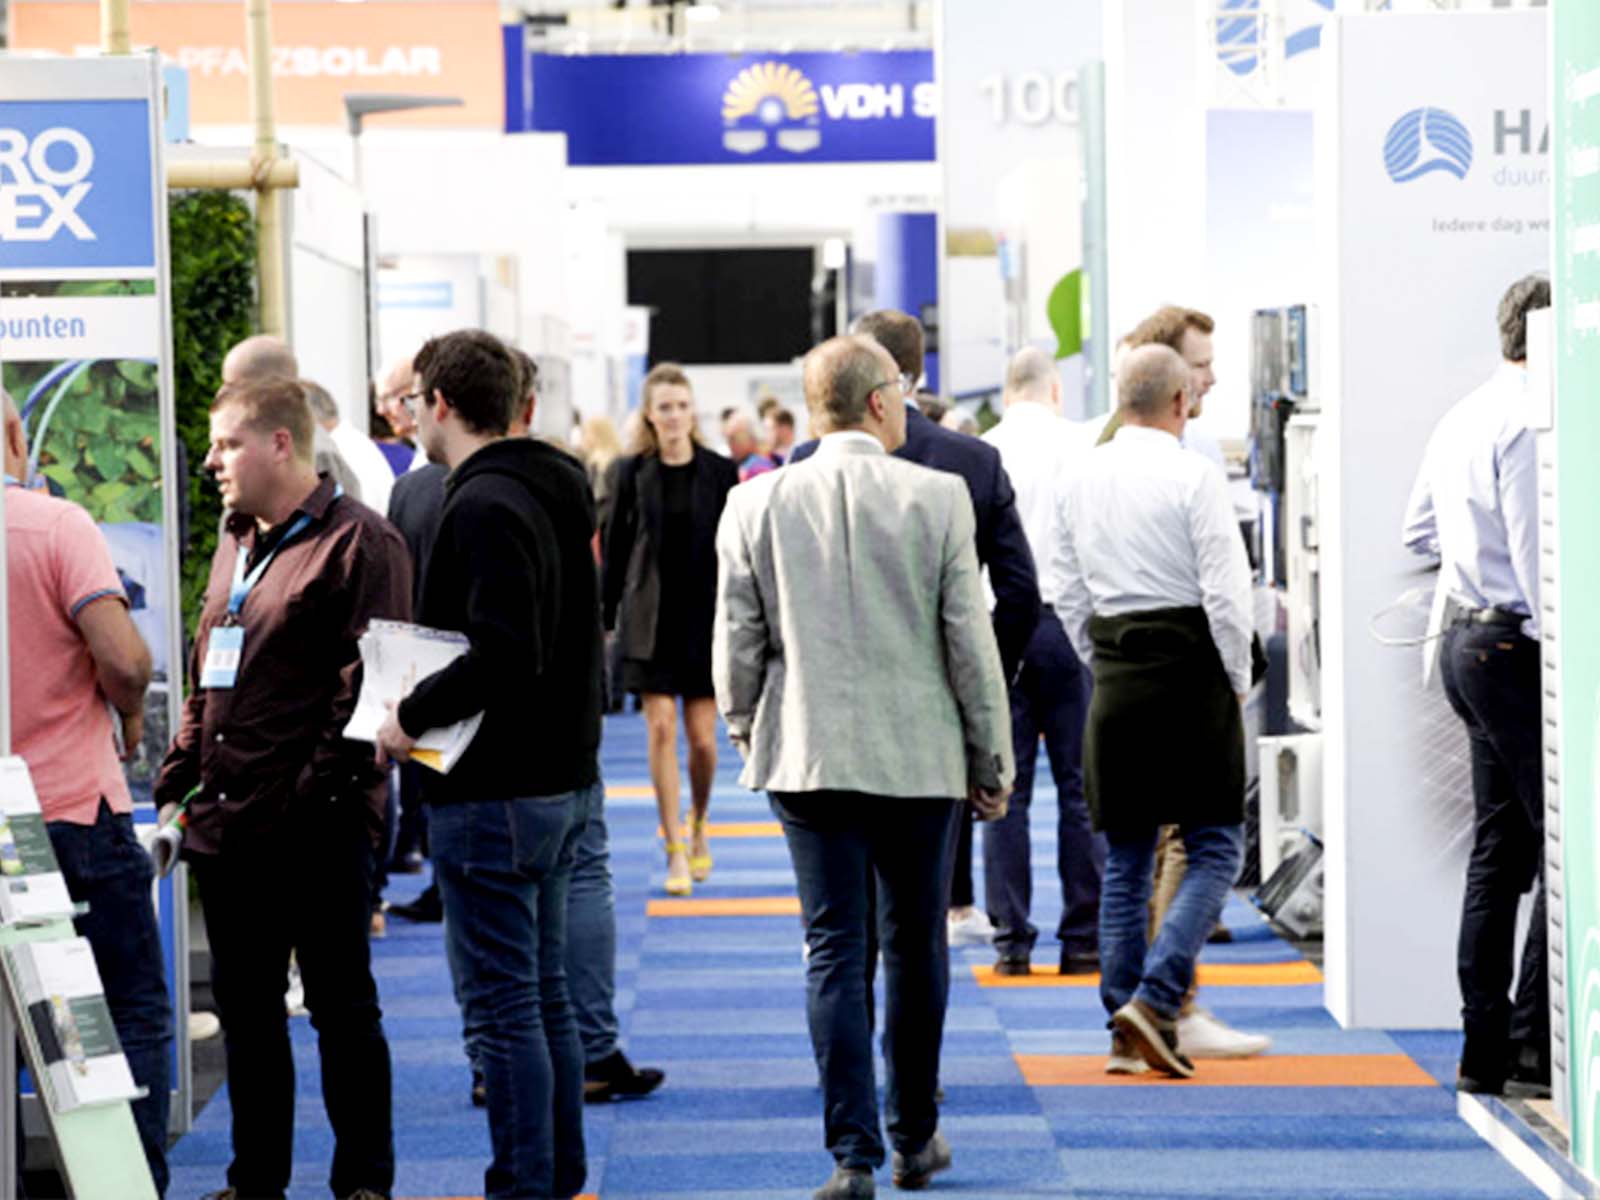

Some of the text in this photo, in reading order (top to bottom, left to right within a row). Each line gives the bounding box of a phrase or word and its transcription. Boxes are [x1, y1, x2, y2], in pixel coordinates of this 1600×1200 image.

[178, 46, 441, 77] PFAZSOLAR
[820, 83, 905, 119] VDH
[0, 127, 95, 187] RO
[1493, 166, 1550, 186] duur
[1491, 217, 1521, 235] dag
